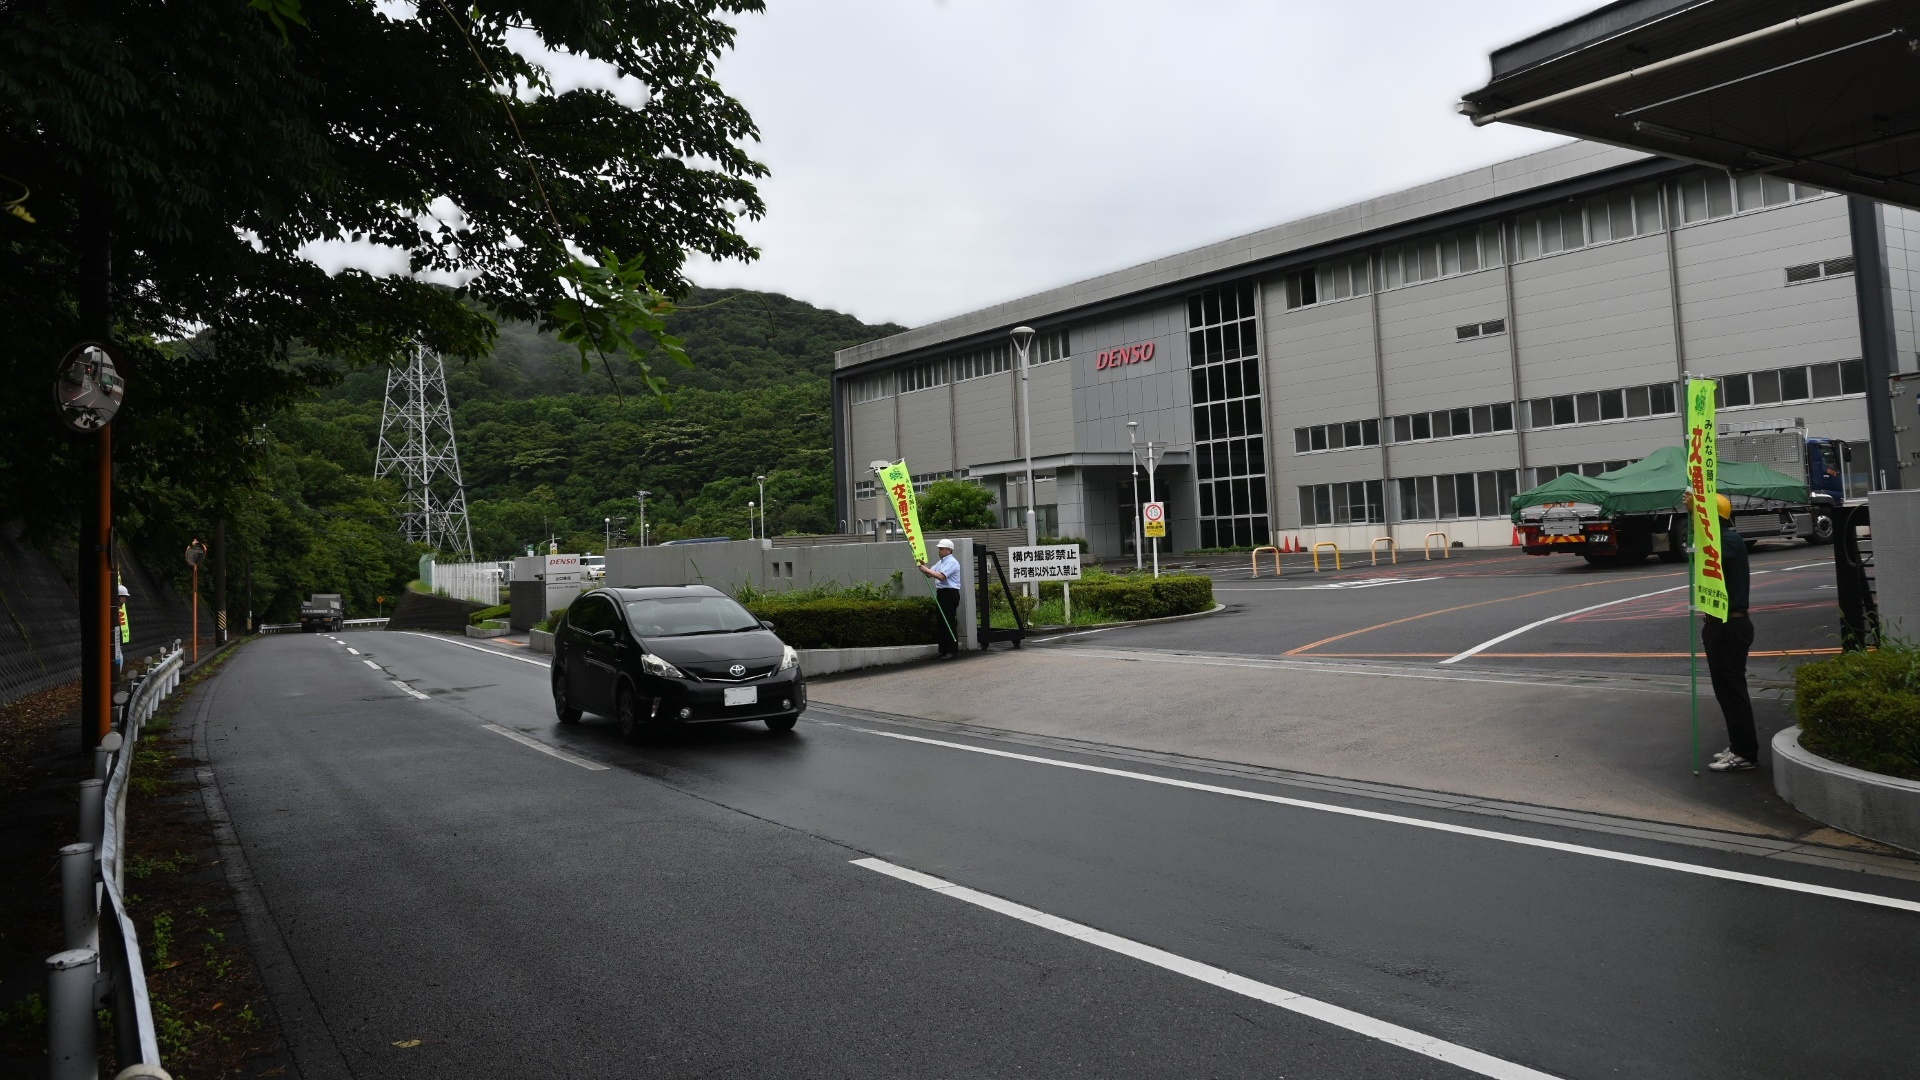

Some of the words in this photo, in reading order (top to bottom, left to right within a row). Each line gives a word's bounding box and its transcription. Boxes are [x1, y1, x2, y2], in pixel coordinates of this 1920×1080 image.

[1096, 341, 1155, 370] DENSO
[1704, 420, 1714, 493] みんなの願い
[1150, 508, 1159, 517] 15
[1012, 549, 1077, 562] 構内撮影禁止
[1013, 565, 1078, 578] 許可者以外立入禁止
